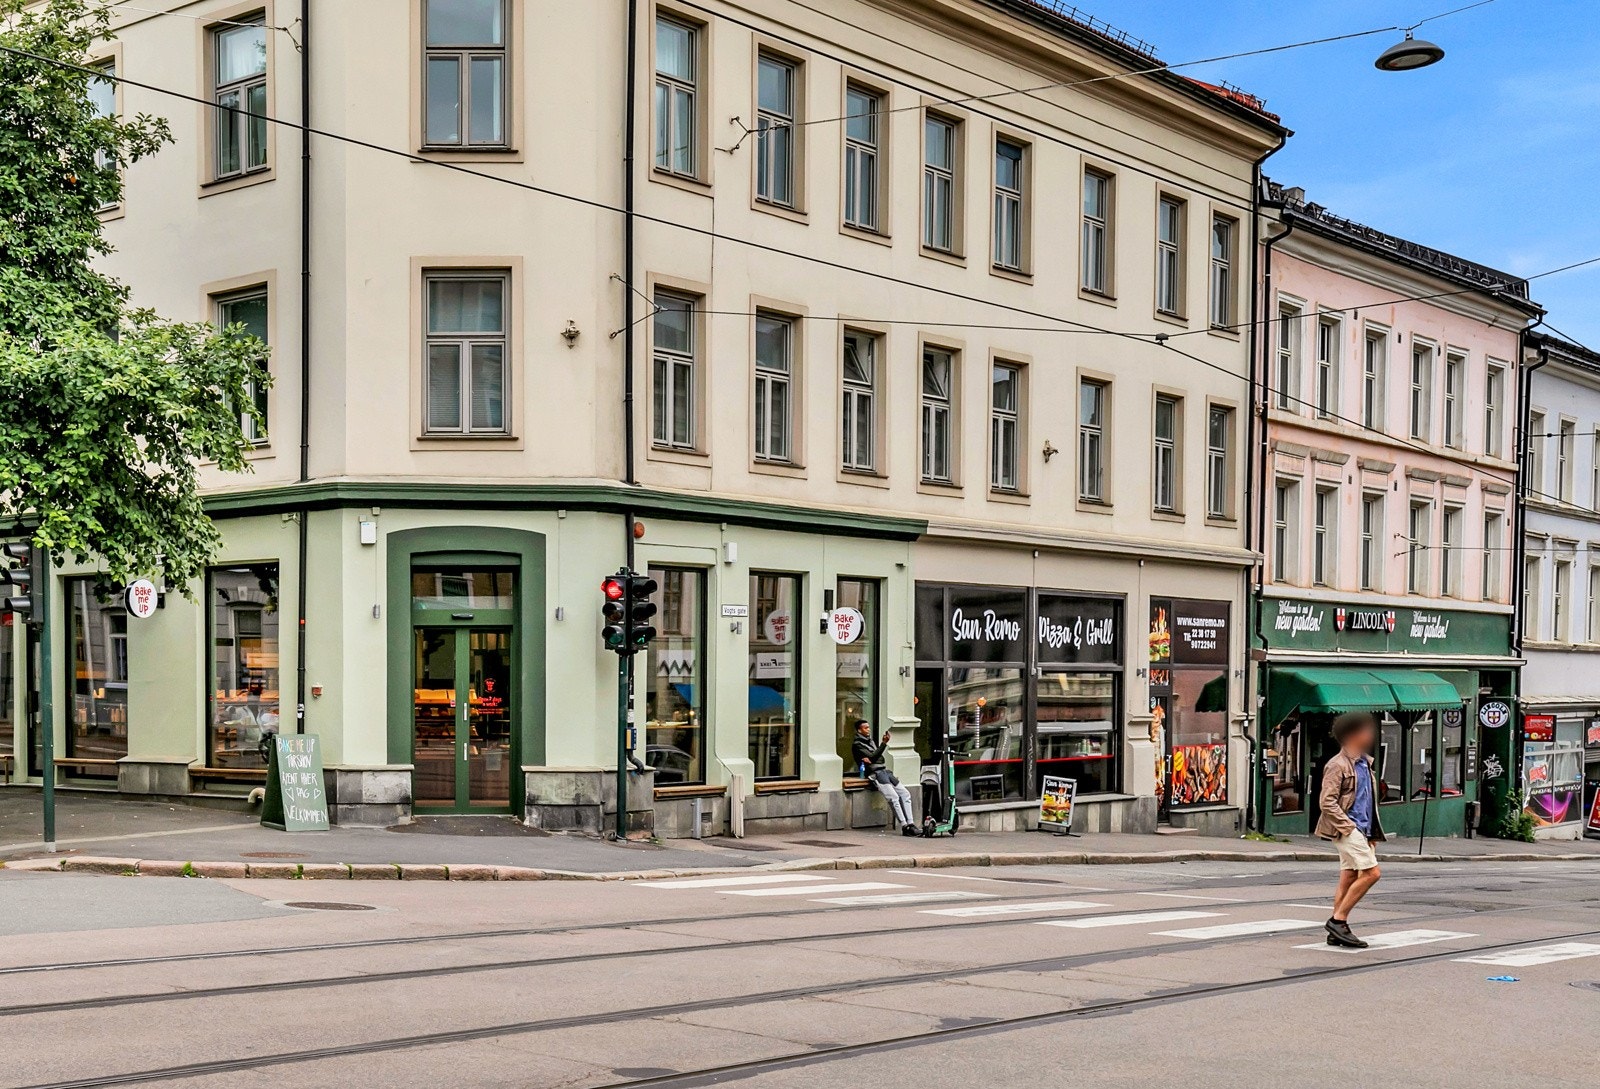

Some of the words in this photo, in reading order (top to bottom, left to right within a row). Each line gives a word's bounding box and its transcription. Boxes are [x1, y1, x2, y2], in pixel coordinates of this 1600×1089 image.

[135, 587, 151, 596] Bake
[1279, 601, 1296, 614] Welcome
[834, 614, 853, 623] Bake
[1177, 617, 1225, 627] www.sanremo.no
[1275, 615, 1292, 630] new
[1292, 606, 1323, 637] garden!
[1352, 612, 1388, 630] LINCOLN
[952, 608, 981, 641] San
[984, 609, 1021, 641] Remo
[1038, 616, 1071, 649] Pizza
[1073, 615, 1082, 650] &
[1086, 618, 1113, 645] Grill
[1192, 629, 1197, 637] 22
[1410, 625, 1424, 637] new
[1423, 615, 1449, 644] garden!
[1481, 703, 1507, 715] LINCOLN
[278, 738, 294, 752] BAKE
[296, 739, 304, 752] ME
[306, 738, 315, 752] UP
[296, 787, 310, 798] DAG
[285, 804, 328, 823] VELKOMMEN
